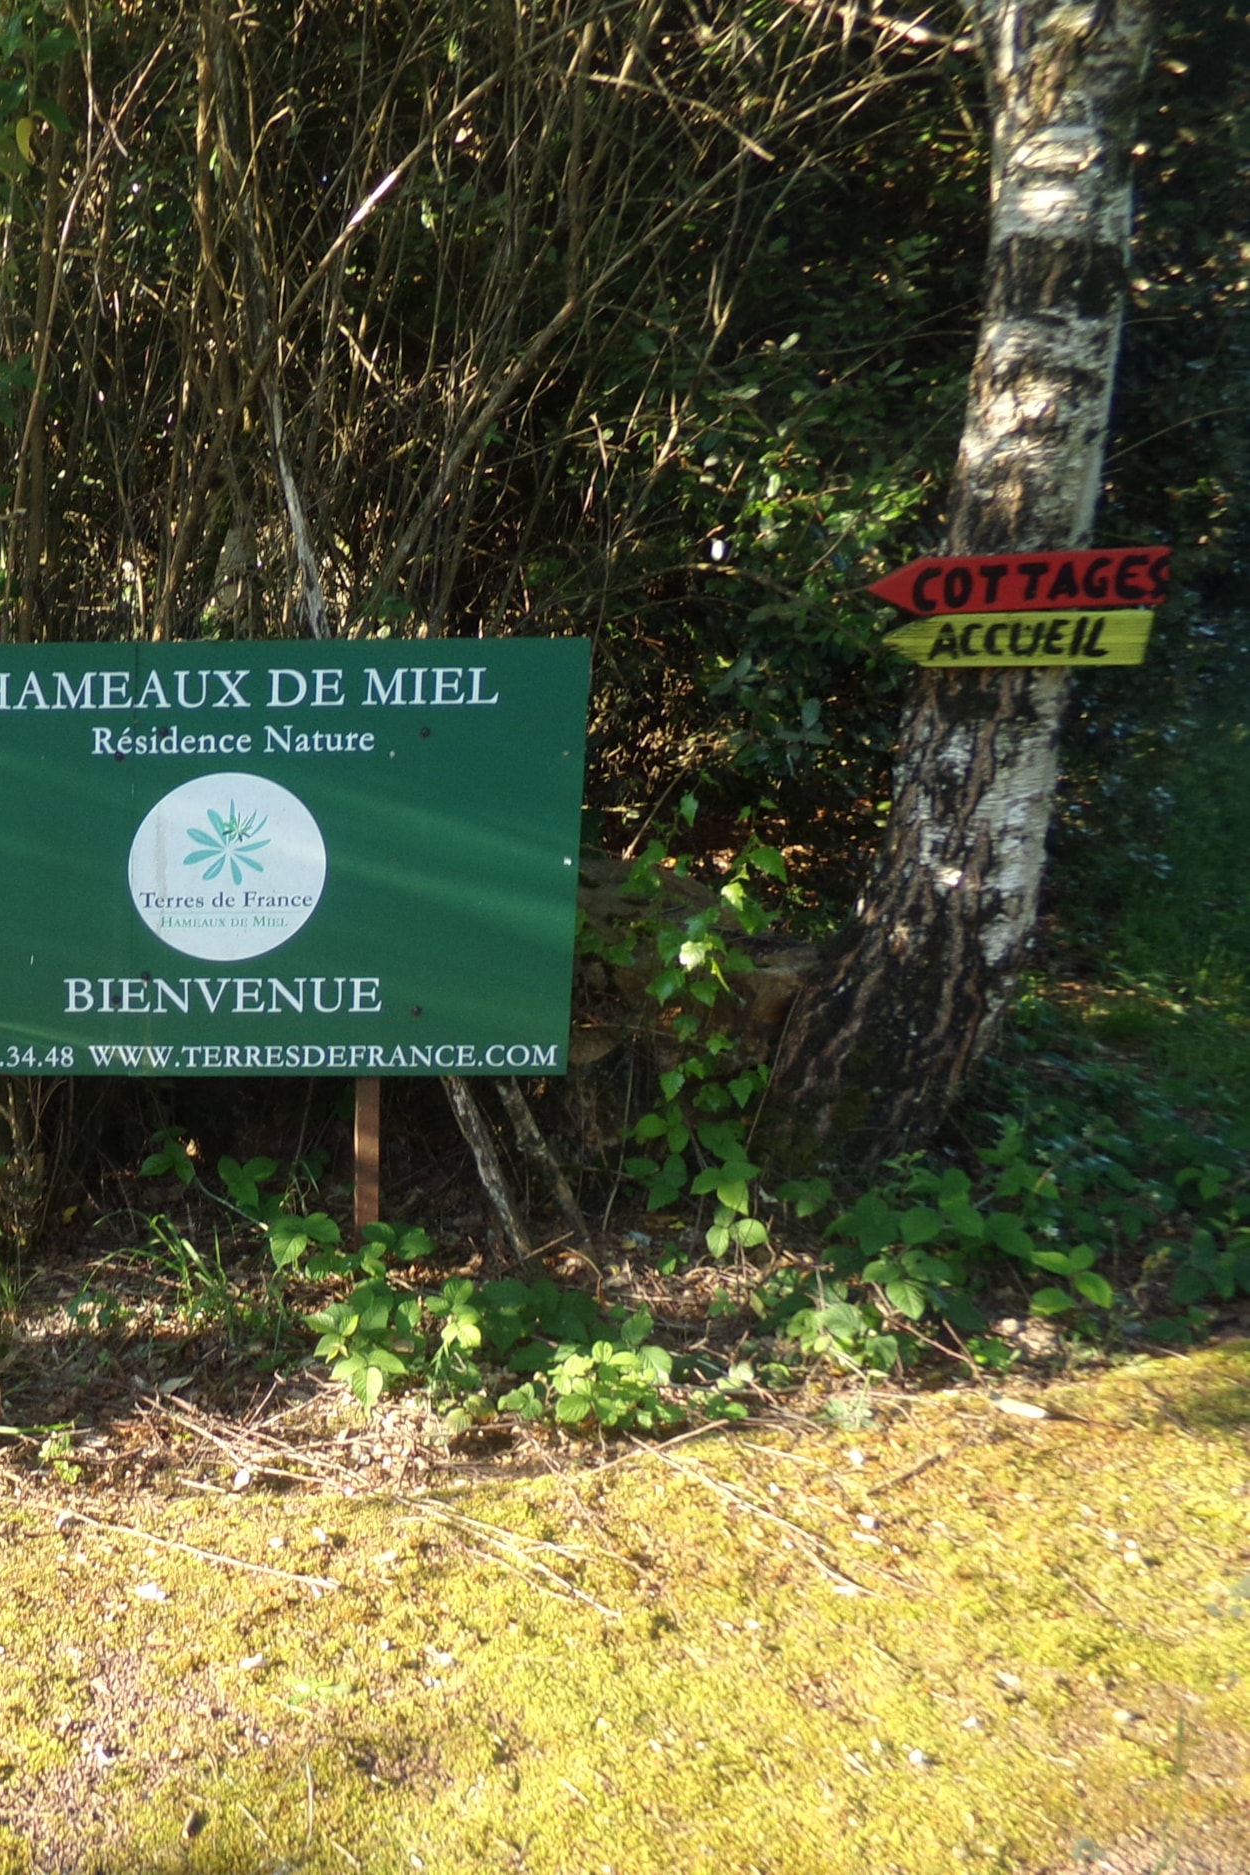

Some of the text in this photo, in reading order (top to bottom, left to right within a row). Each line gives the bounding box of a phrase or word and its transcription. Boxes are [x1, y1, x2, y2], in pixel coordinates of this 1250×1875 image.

[912, 555, 1170, 612] COTTAGES
[928, 616, 1108, 660] ACCUEIL
[266, 669, 345, 708] DE
[361, 667, 499, 706] MIEL
[91, 726, 375, 756] Résidence Nature
[139, 891, 313, 908] Terres de France
[160, 916, 226, 928] HAMEAUX
[63, 977, 382, 1014] BIENVENUE
[88, 1043, 557, 1068] WWW.TERRESDEFRANCE.COM
